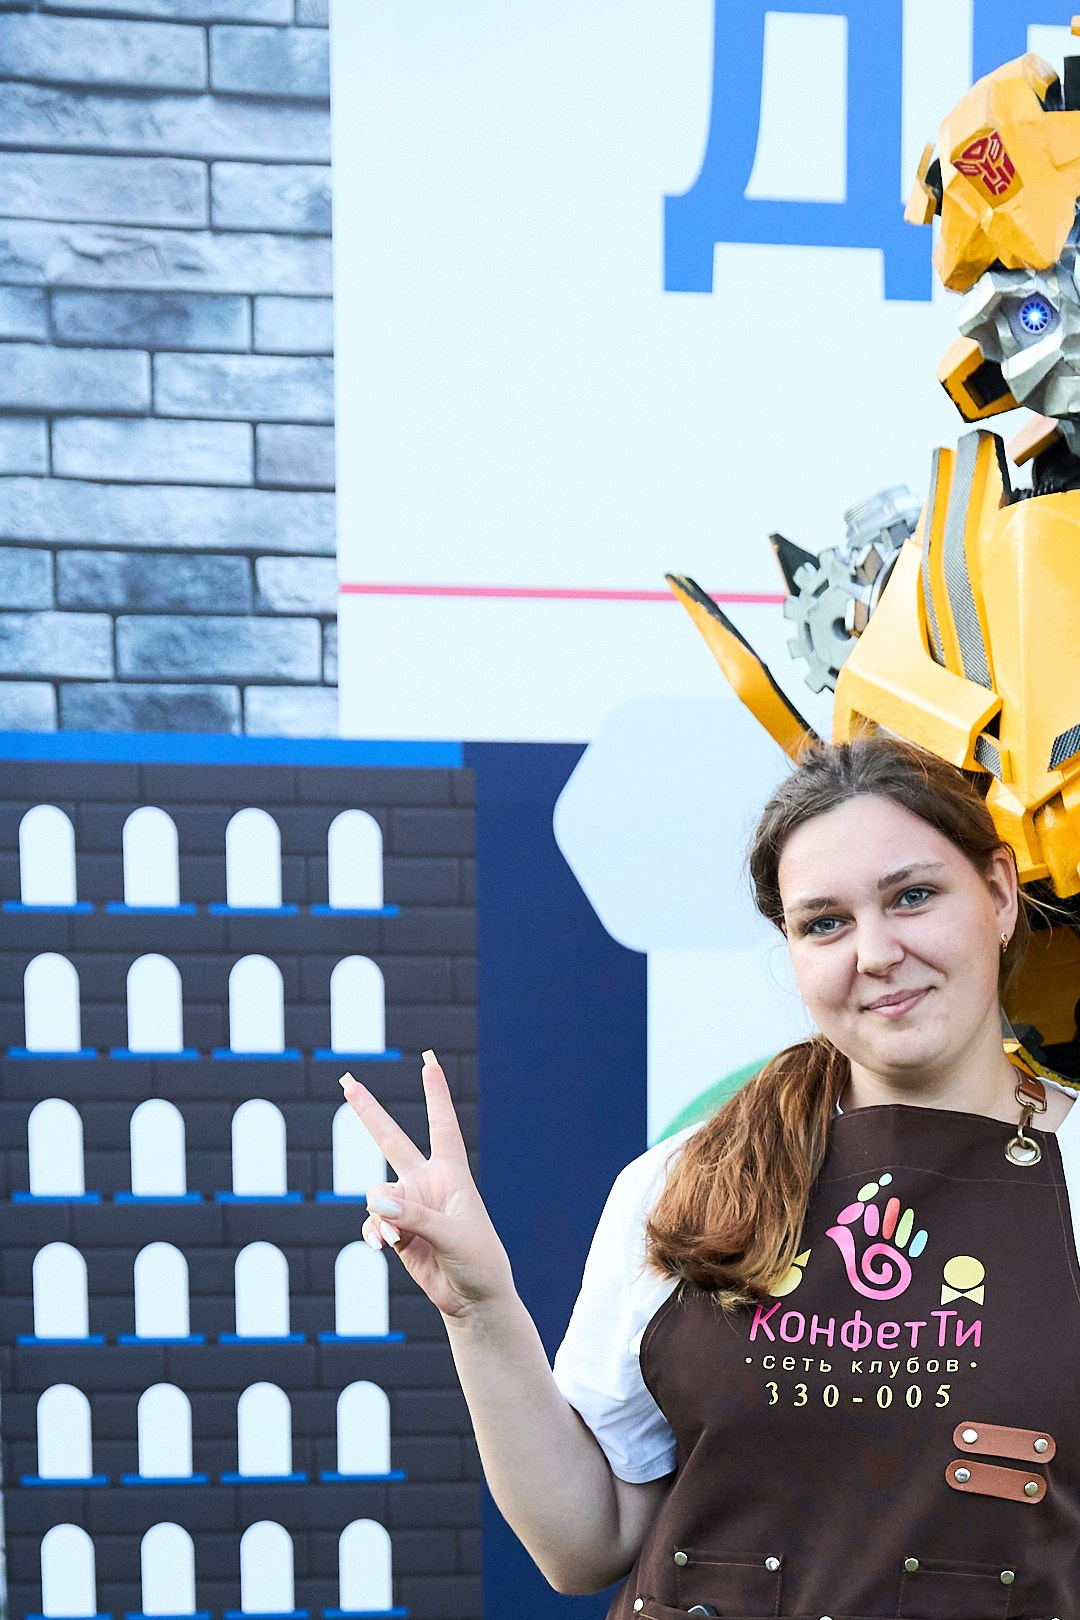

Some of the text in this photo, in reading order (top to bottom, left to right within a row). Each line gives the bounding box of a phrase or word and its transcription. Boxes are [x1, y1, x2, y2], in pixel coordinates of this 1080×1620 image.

[749, 1301, 982, 1352] КонфетТи
[762, 1355, 960, 1378] сеть клубов
[765, 1381, 951, 1409] 330-005
